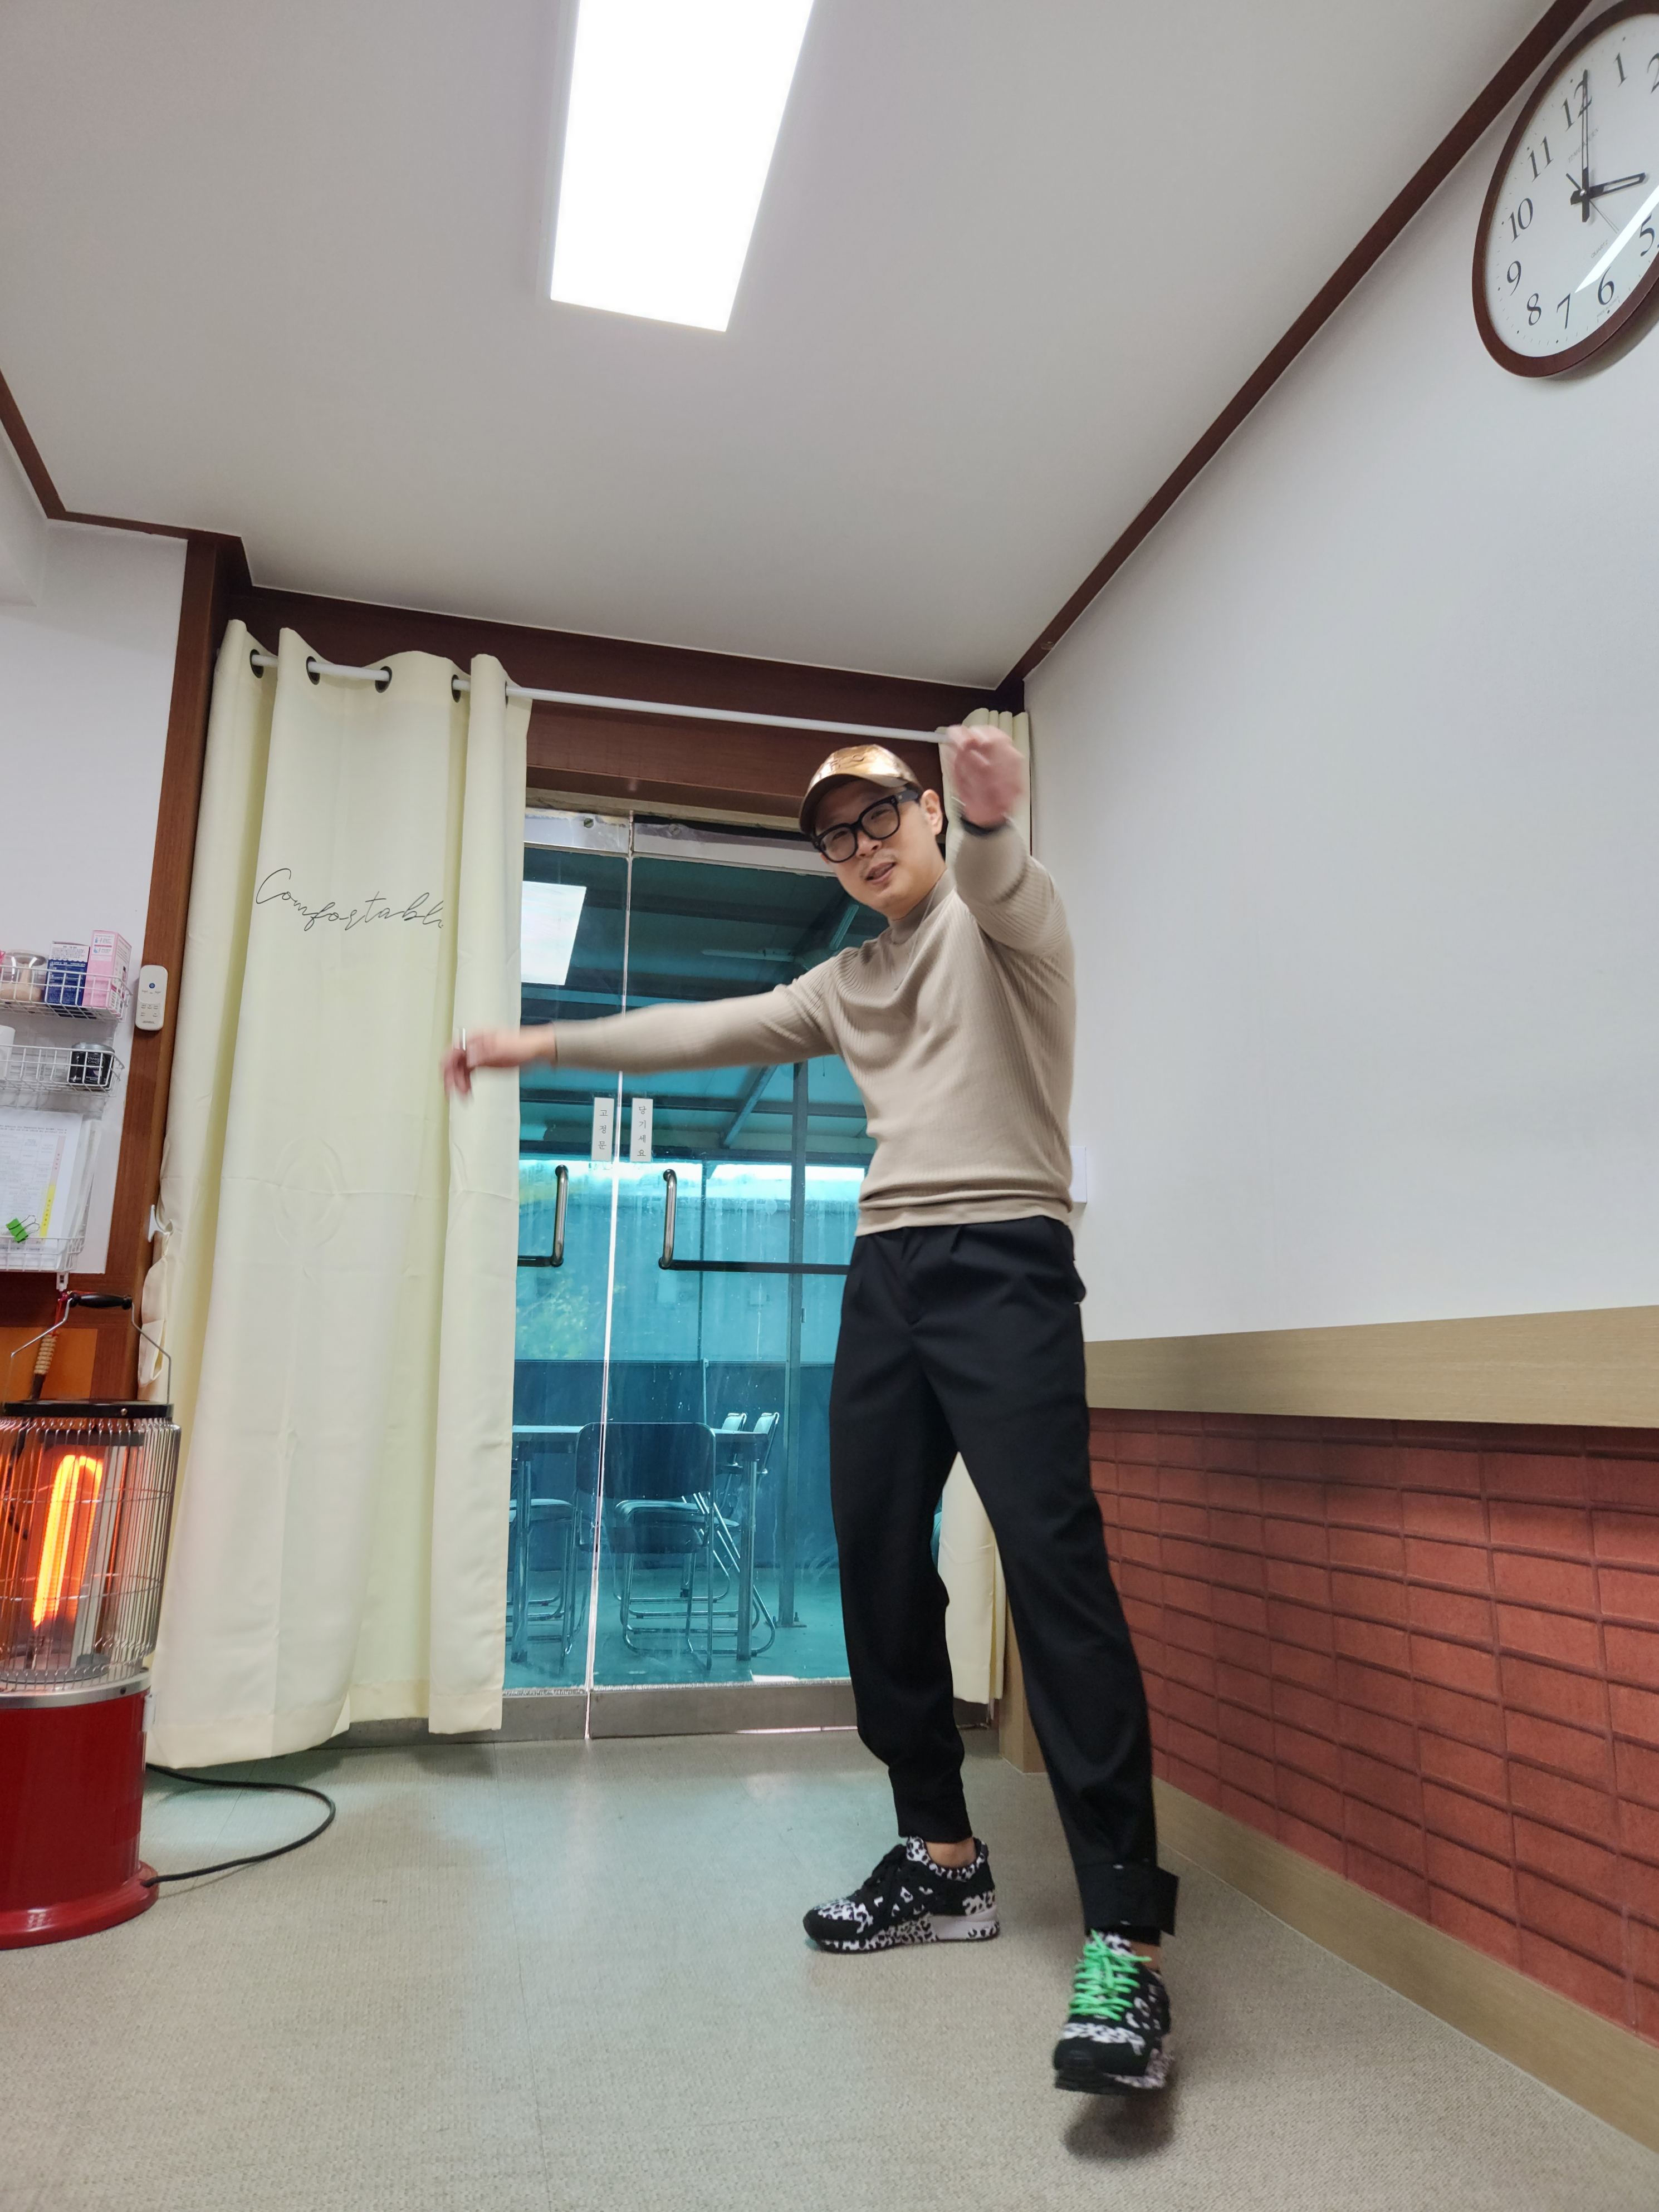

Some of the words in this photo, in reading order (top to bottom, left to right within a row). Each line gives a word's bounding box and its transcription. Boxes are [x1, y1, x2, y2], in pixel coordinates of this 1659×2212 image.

[1612, 51, 1628, 88] 1
[1560, 79, 1593, 132] 12
[1527, 135, 1554, 183] 11
[1508, 197, 1533, 243] 10
[1639, 212, 1655, 257] 5
[1591, 239, 1608, 259] QUARTZ
[1506, 260, 1521, 296] 9
[1597, 266, 1614, 306] 6
[1526, 292, 1541, 326] 8
[1556, 293, 1571, 330] 7
[598, 1110, 608, 1149] 고정문
[637, 1106, 647, 1156] 당기세요
